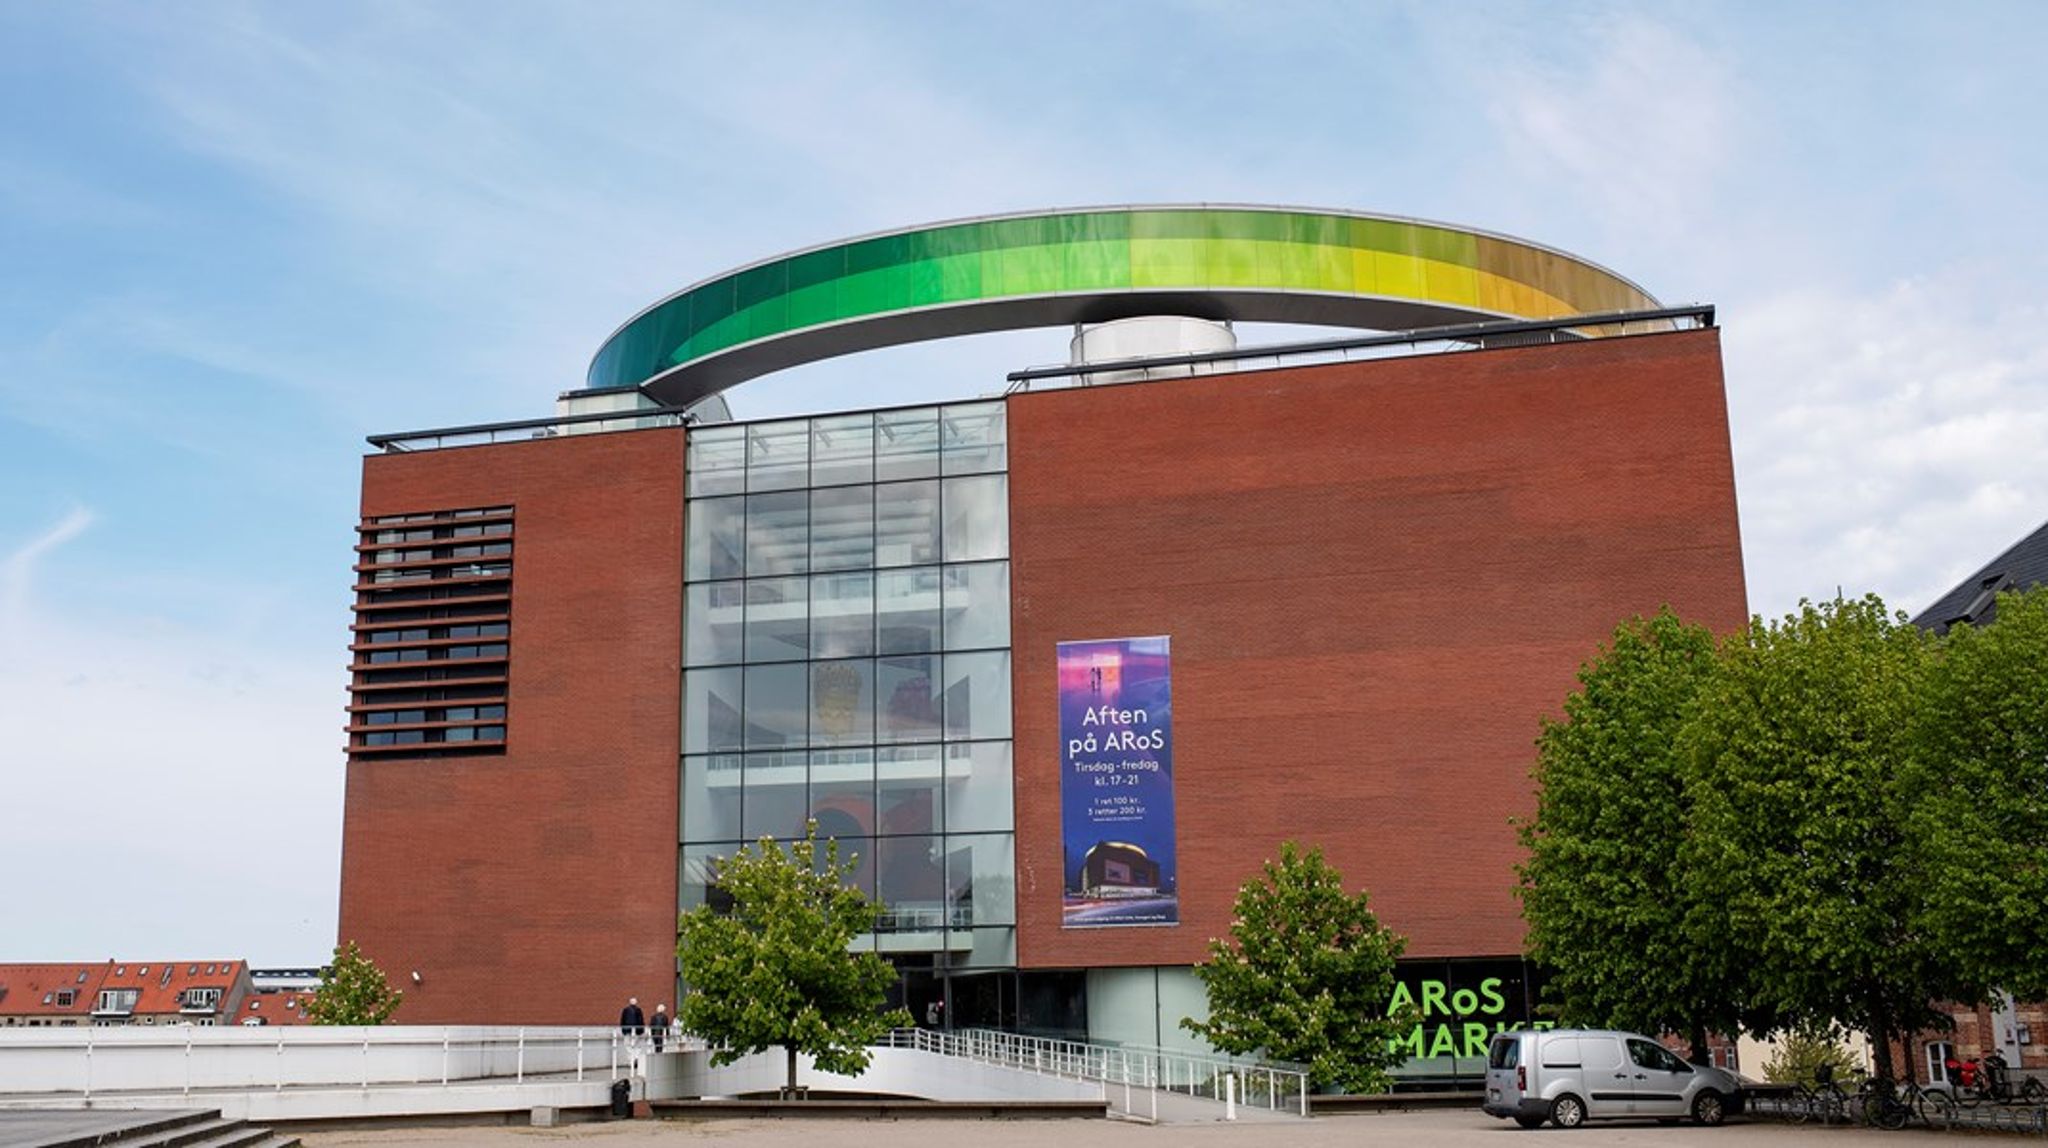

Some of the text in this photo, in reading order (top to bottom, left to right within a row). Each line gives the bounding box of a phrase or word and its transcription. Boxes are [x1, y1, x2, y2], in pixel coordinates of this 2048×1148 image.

[1082, 705, 1148, 726] Aften
[1069, 729, 1165, 759] på ARoS
[1113, 795, 1127, 804] 100
[1119, 806, 1135, 815] 200
[1387, 978, 1505, 1016] ARoS
